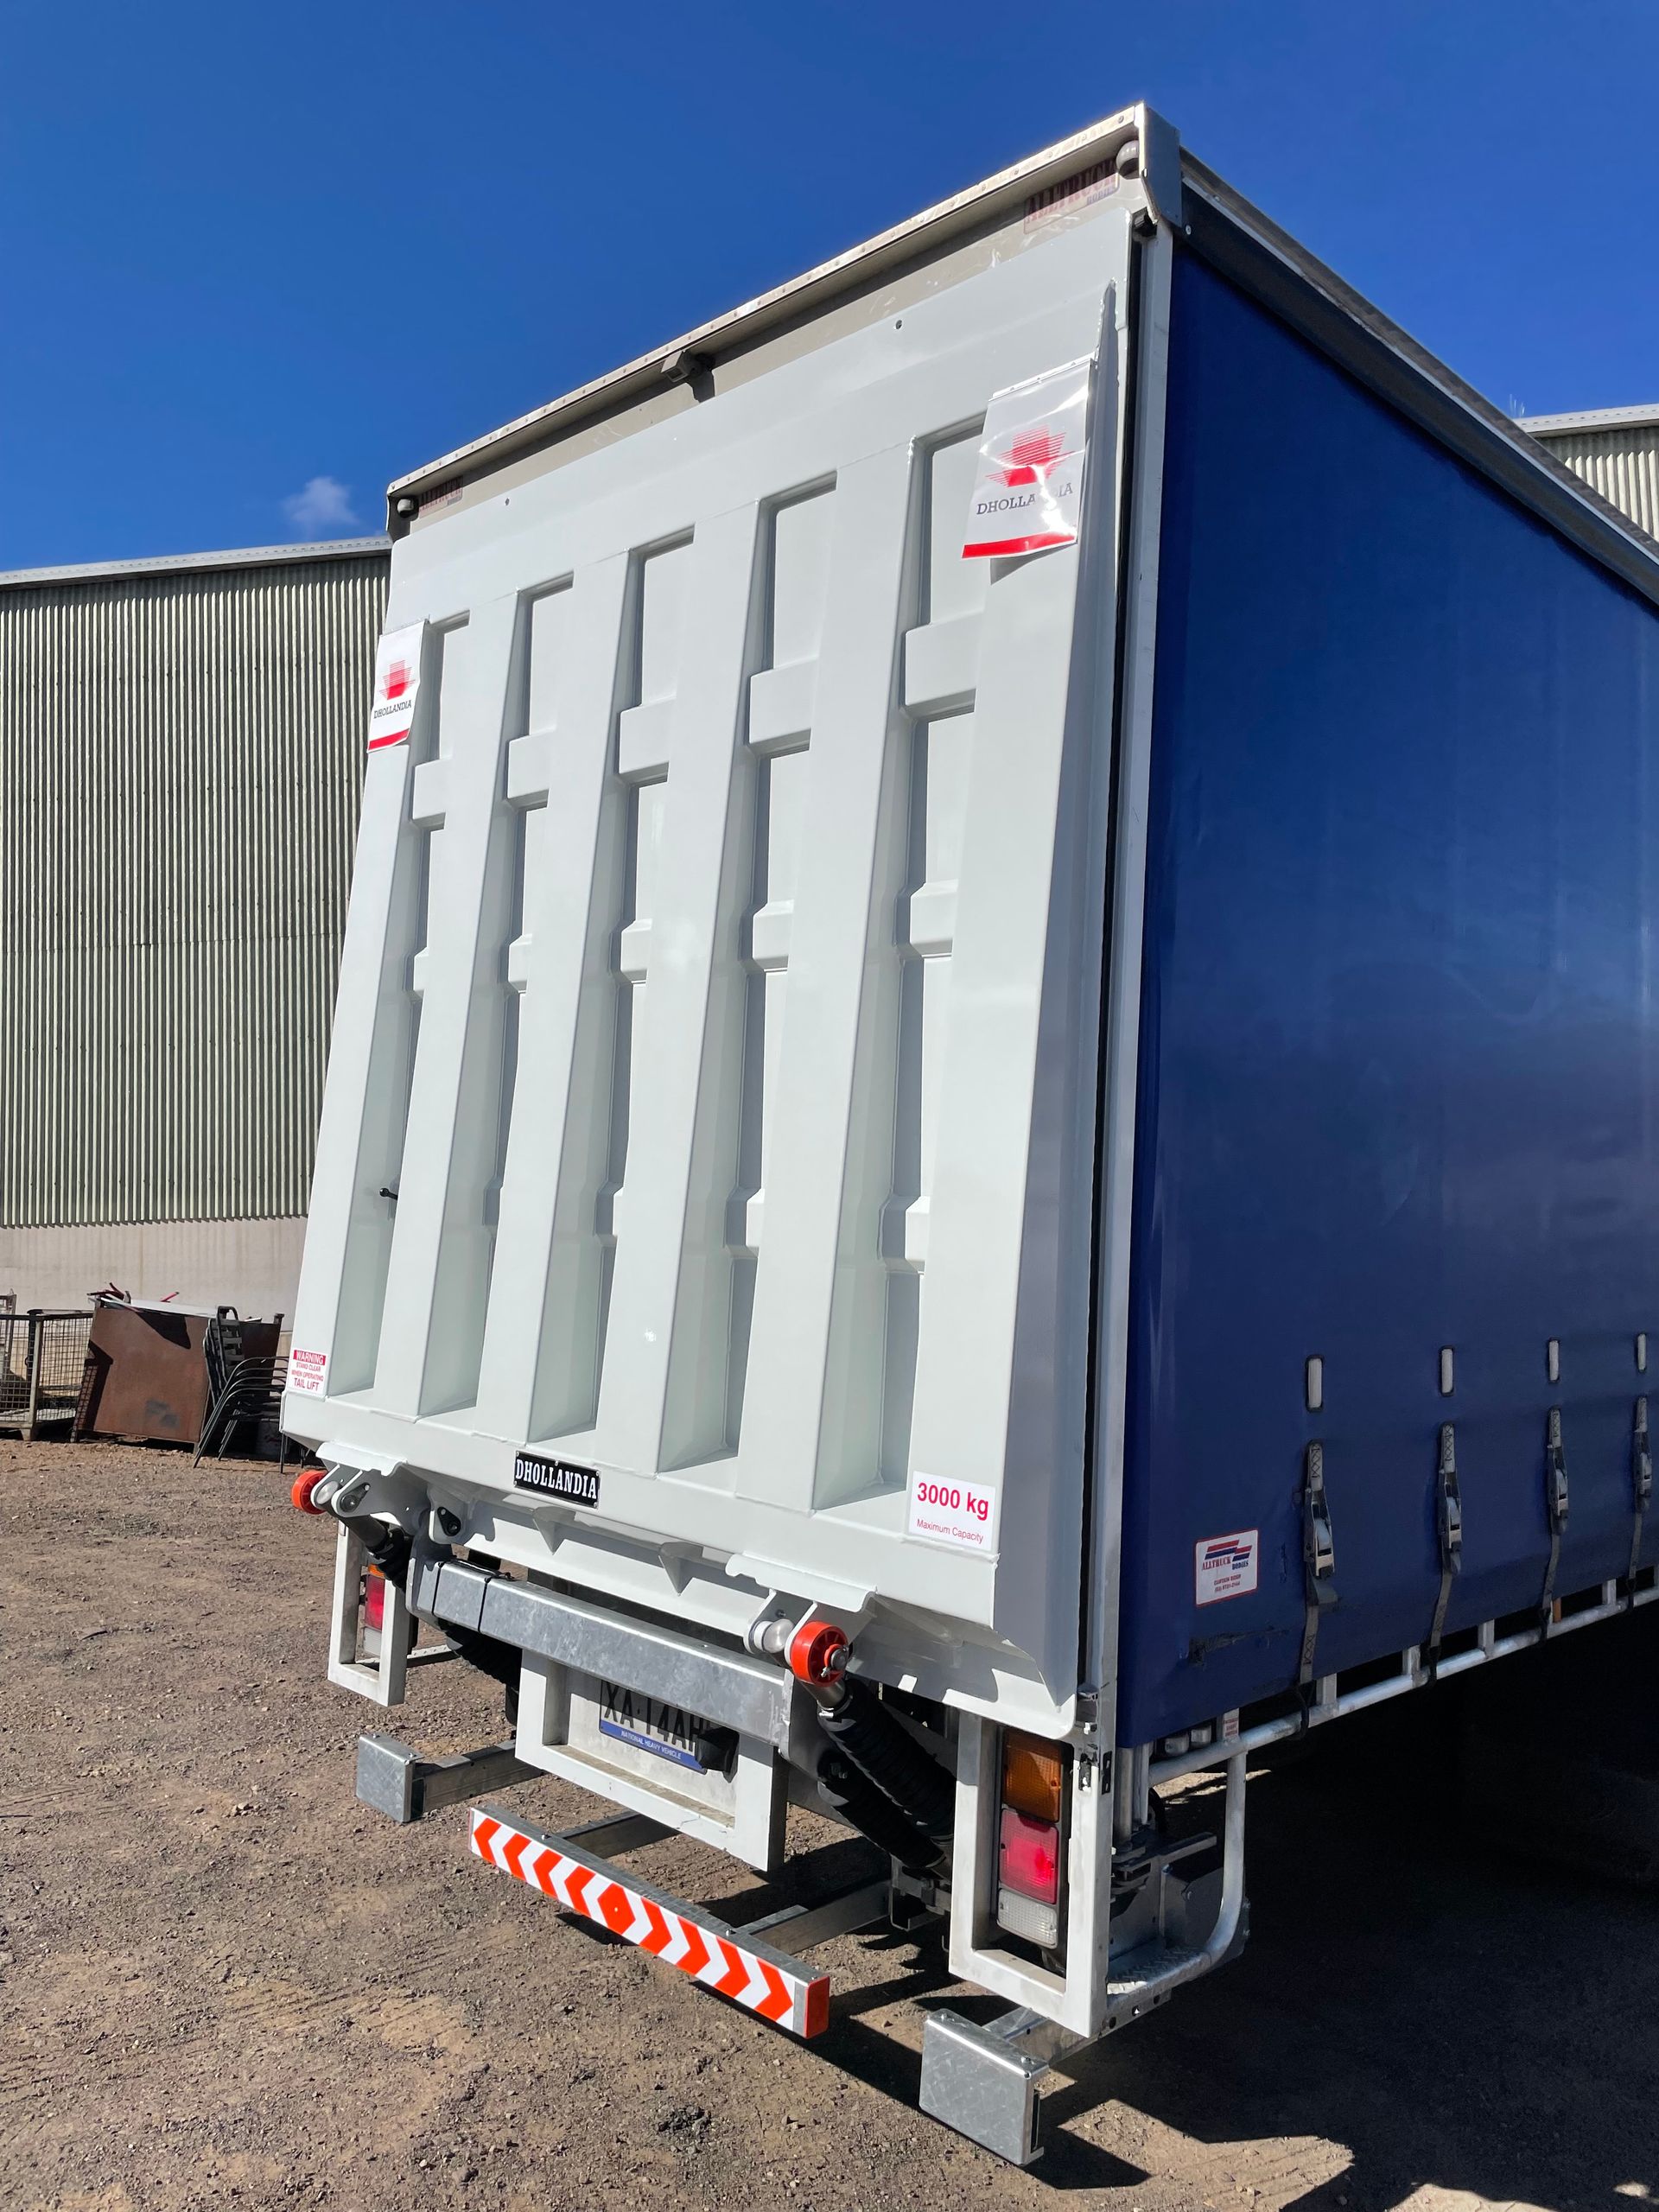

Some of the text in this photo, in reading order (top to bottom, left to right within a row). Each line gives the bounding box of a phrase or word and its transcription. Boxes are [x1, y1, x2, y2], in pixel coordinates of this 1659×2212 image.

[373, 699, 412, 720] DHOLLANDIA
[296, 1351, 324, 1365] WARNING
[296, 1362, 308, 1370] STAND
[294, 1377, 320, 1391] TAIL LIFT
[302, 1371, 324, 1382] OPERATING
[515, 1459, 597, 1500] DHOLLANDIA
[917, 1482, 989, 1522] 3000 kg
[916, 1518, 984, 1545] Maximum Capacity
[1202, 1555, 1231, 1571] ALLTRUCK
[1231, 1560, 1249, 1571] BODIES
[620, 1730, 683, 1760] NATIONAL HEAVY VEHICLE
